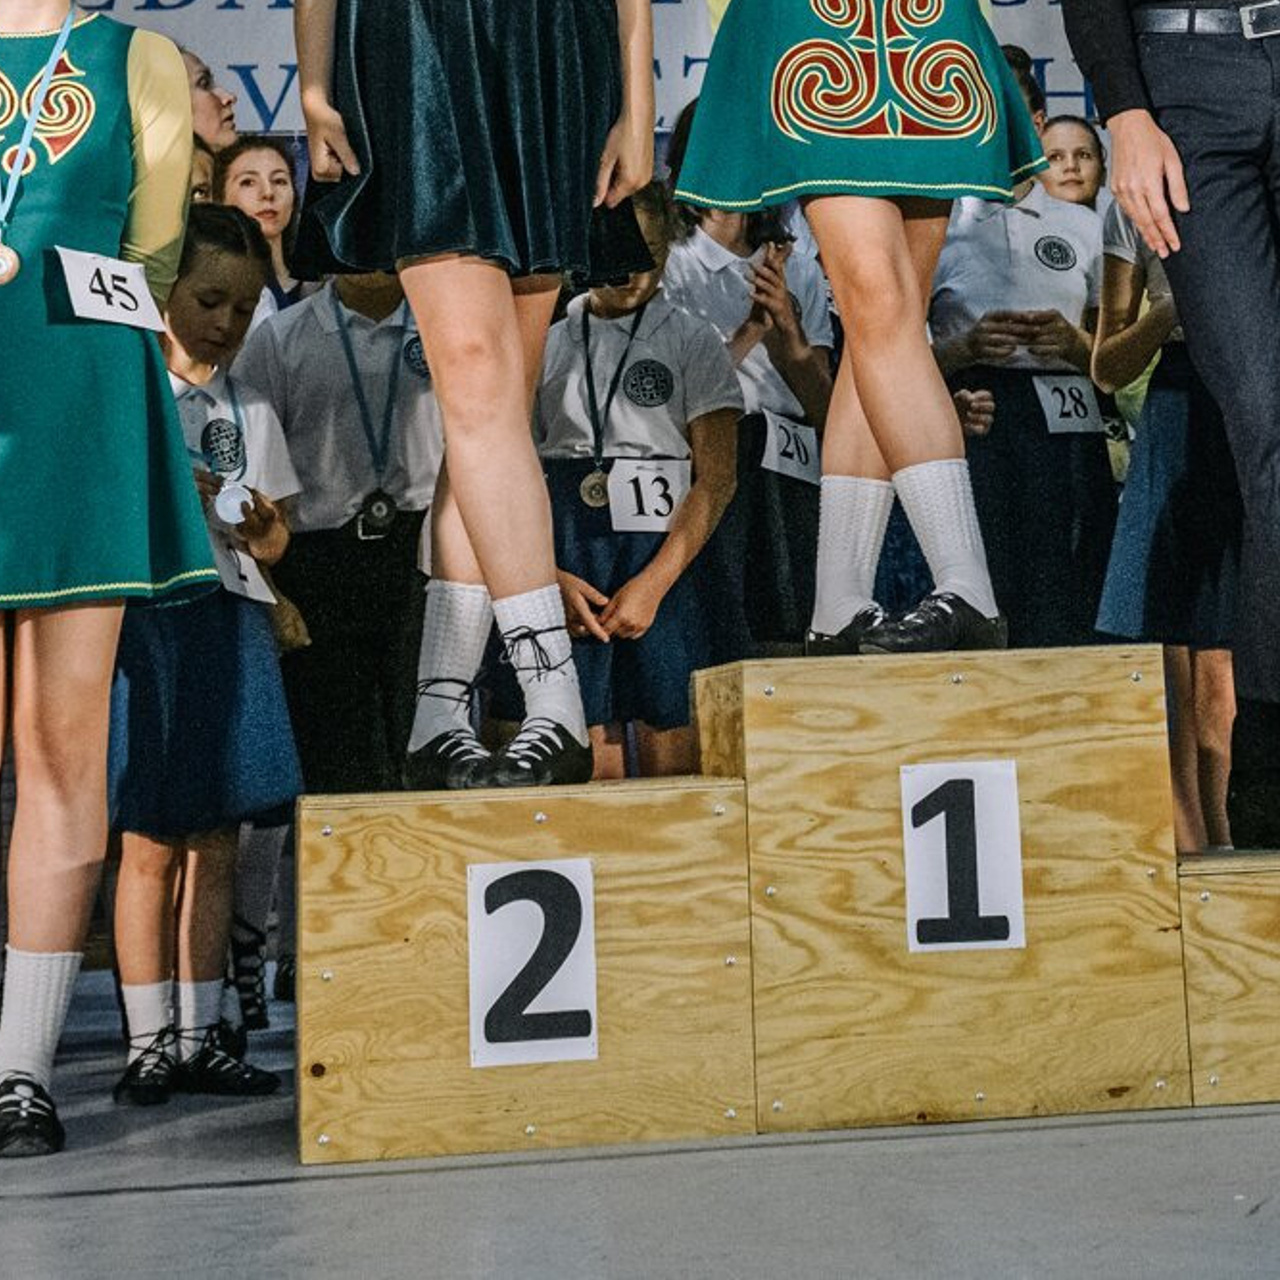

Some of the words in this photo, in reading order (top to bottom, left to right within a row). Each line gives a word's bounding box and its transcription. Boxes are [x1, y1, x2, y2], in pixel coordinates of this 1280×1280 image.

[89, 267, 139, 311] 45
[1051, 386, 1089, 419] 28
[627, 475, 674, 517] 13
[911, 778, 1010, 945] 1
[483, 869, 593, 1044] 2
